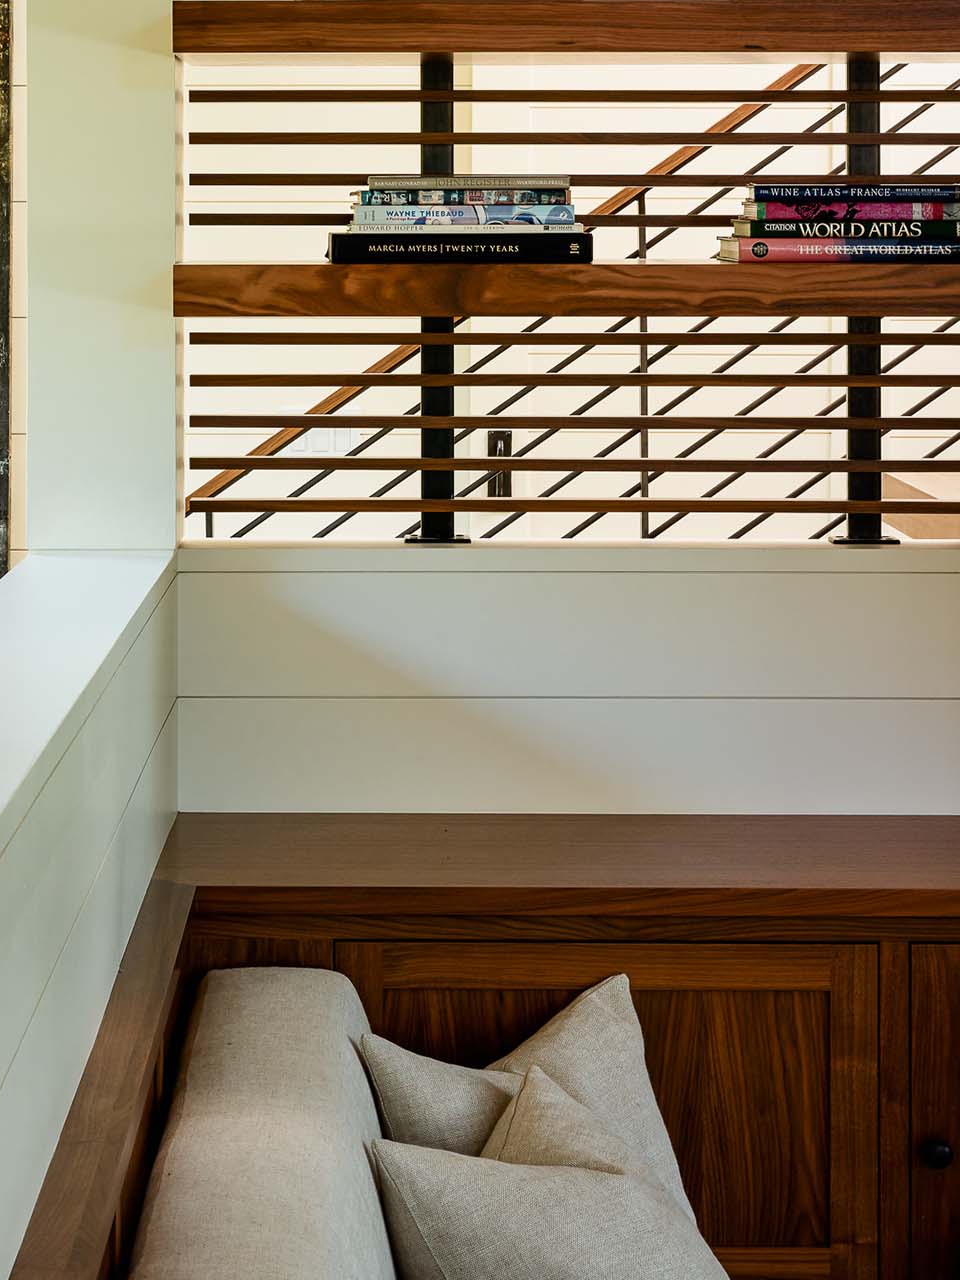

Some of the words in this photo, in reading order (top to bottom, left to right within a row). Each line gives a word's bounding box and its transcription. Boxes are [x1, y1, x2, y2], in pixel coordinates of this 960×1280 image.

[435, 178, 463, 187] JOHN
[463, 178, 511, 187] REGISTER
[771, 188, 799, 196] WINE
[804, 188, 841, 196] ATLAS
[850, 188, 891, 197] FRANCE
[764, 223, 796, 231] CITATION
[799, 222, 865, 237] WORLD
[868, 222, 922, 237] ATLAS
[445, 245, 486, 253] TWENTY
[489, 245, 519, 253] YEARS
[799, 245, 822, 255] THE
[824, 245, 864, 255] GREAT
[868, 245, 913, 255] WORLD
[914, 245, 952, 255] ATLAS
